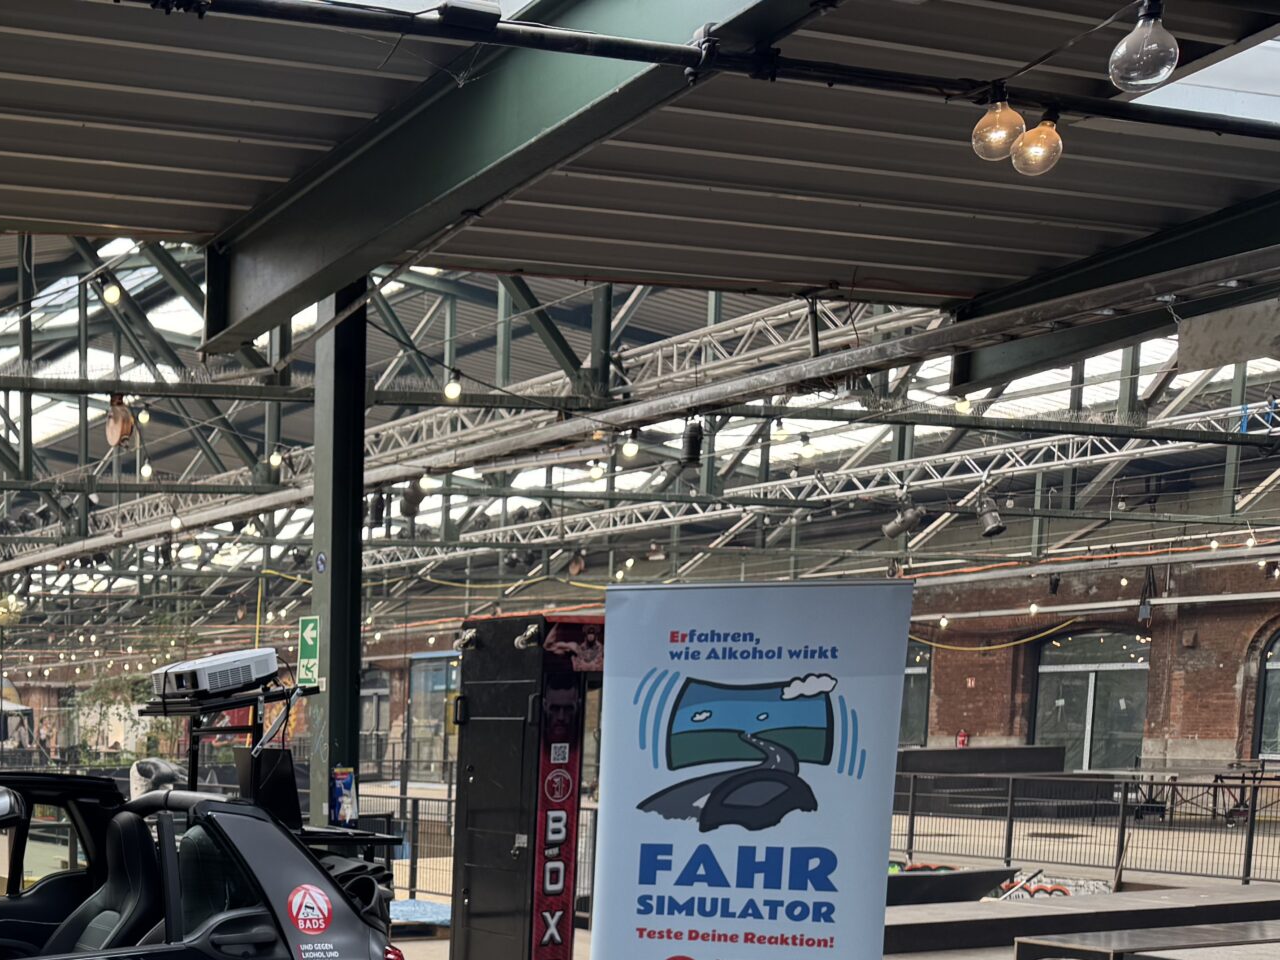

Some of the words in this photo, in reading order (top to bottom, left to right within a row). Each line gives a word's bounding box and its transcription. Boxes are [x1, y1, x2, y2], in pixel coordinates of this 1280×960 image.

[669, 629, 760, 645] Erfahren,
[669, 647, 701, 661] wie
[705, 647, 783, 661] Alkohol
[788, 645, 839, 660] wirkt
[638, 843, 839, 893] FAHR
[636, 894, 835, 924] SIMULATOR
[298, 919, 326, 929] BADS
[636, 927, 684, 940] Teste
[687, 929, 739, 944] Deine
[743, 931, 835, 949] Reaktion!
